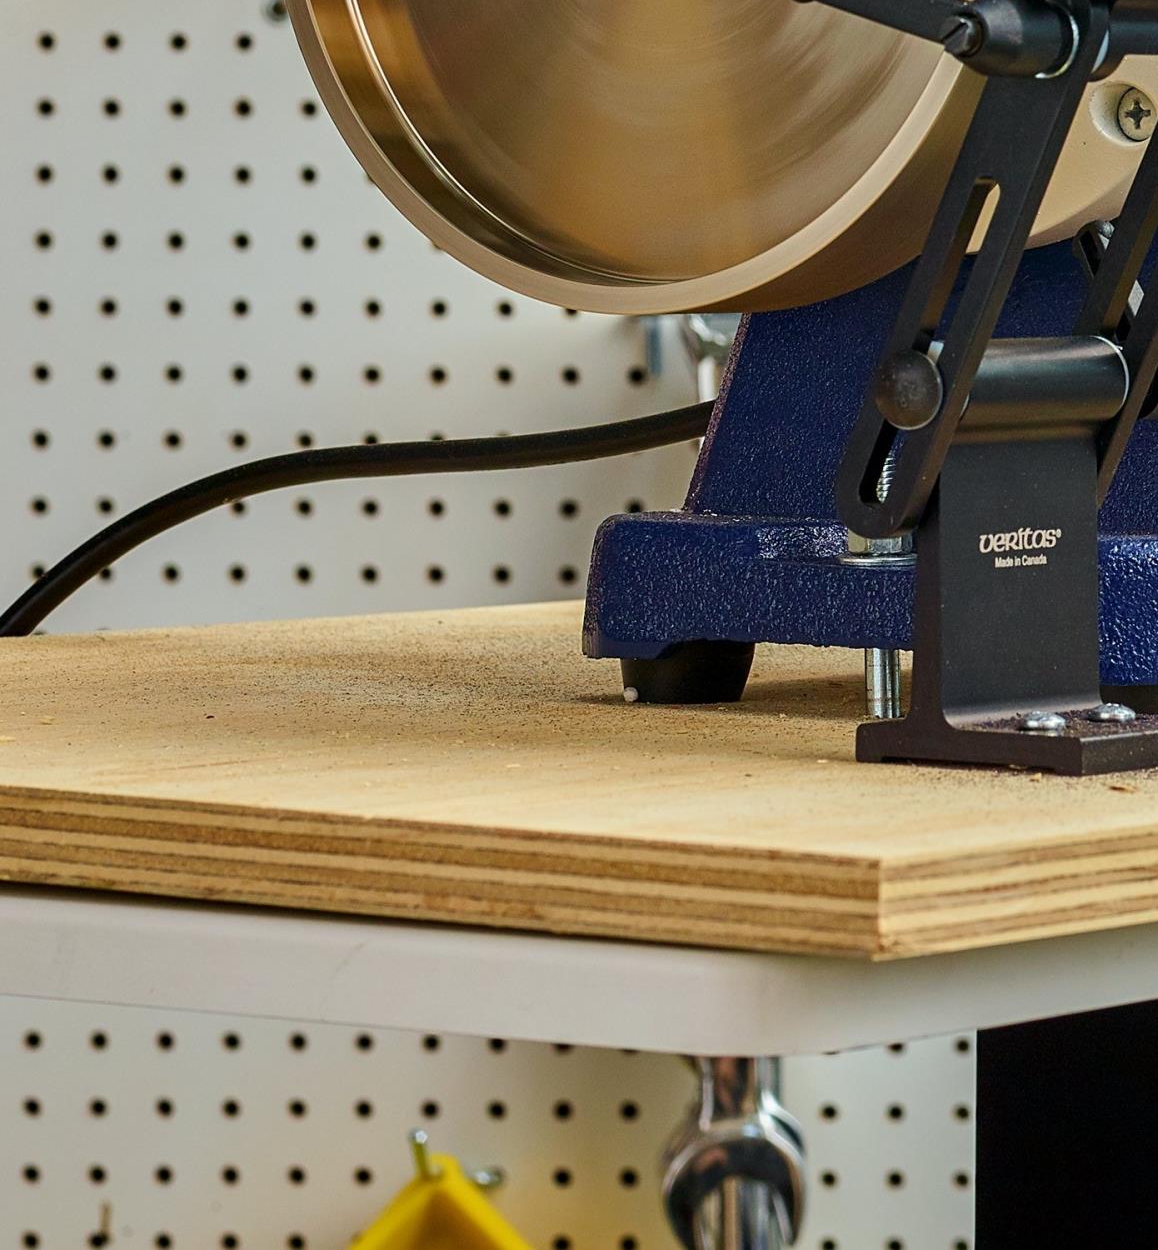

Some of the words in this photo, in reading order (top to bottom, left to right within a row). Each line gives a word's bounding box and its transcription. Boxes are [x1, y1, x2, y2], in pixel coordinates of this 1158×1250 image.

[994, 556, 1014, 569] Made
[1014, 555, 1021, 567] in
[1021, 553, 1048, 567] Canada
